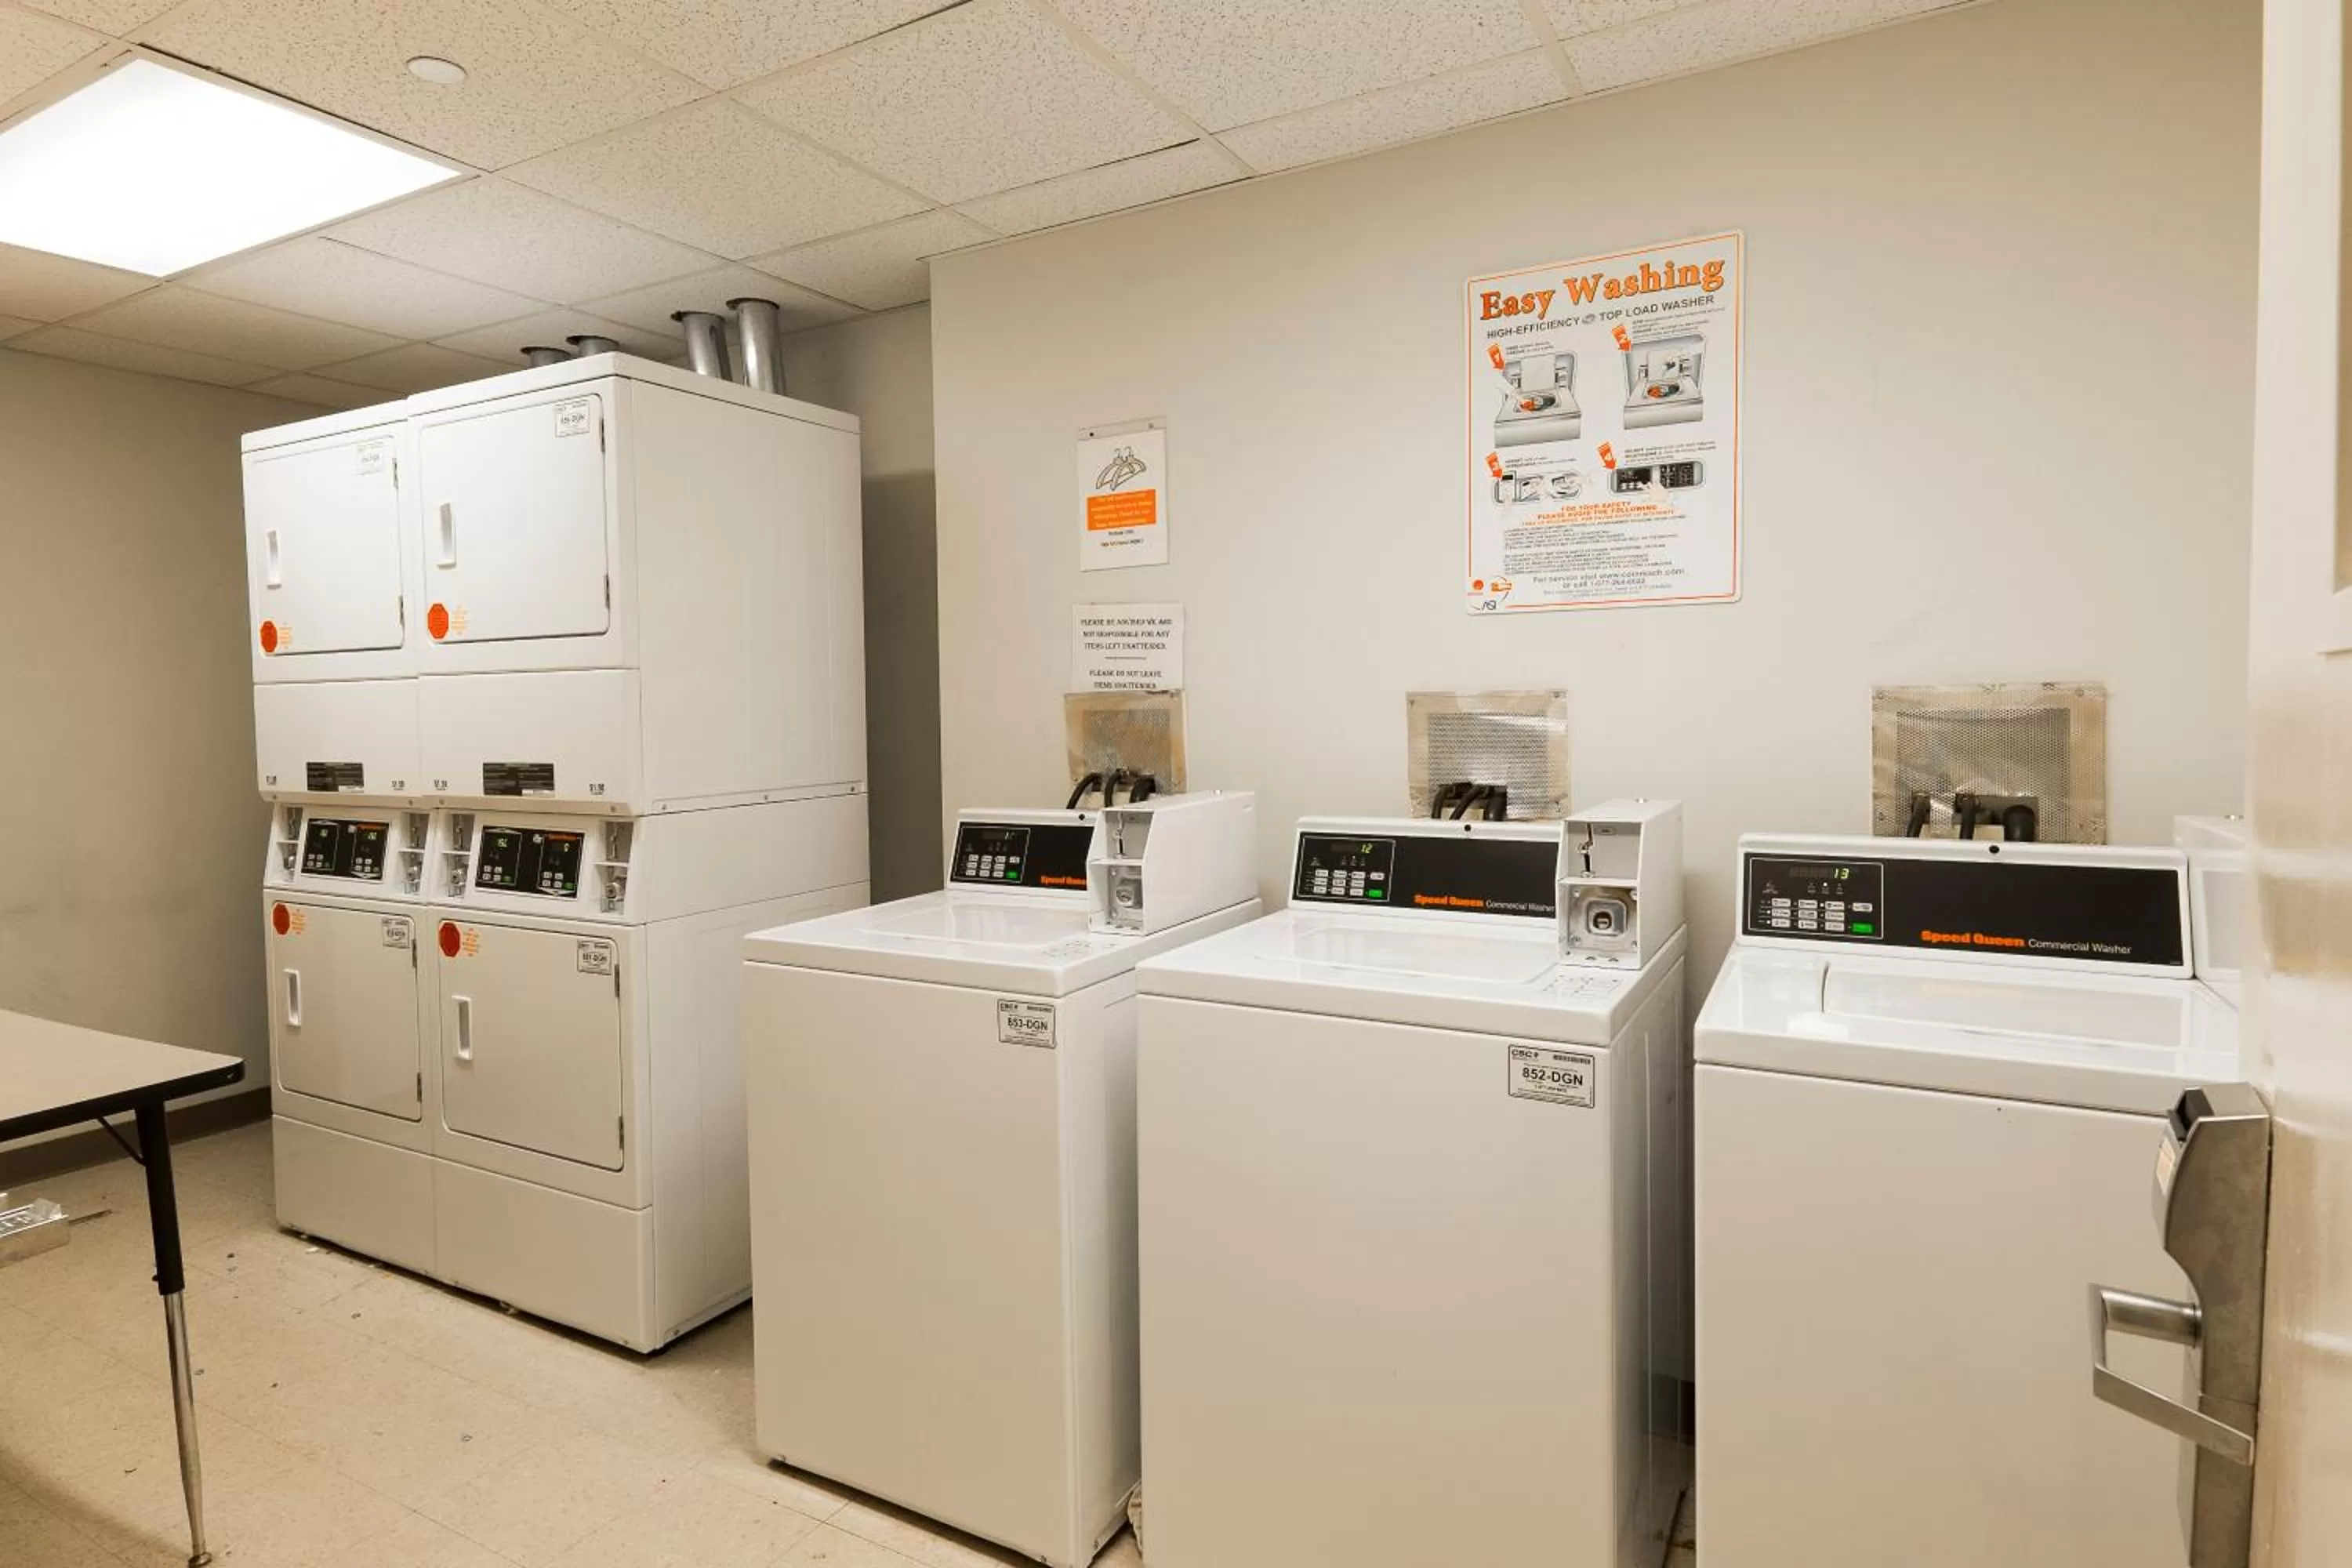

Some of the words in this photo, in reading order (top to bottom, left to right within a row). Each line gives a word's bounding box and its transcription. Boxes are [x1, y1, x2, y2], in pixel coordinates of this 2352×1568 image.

[1480, 288, 1556, 321] Easy
[1563, 260, 1726, 306] Washing
[1486, 317, 1580, 339] HIGH-EFFICIENCY
[1599, 309, 1622, 322] TOP
[1626, 303, 1658, 318] LOAD
[1661, 295, 1715, 313] WASHER
[1834, 868, 1849, 879] 13
[1414, 894, 1448, 906] Speed
[1921, 931, 1970, 943] Speed
[1973, 933, 2025, 947] Queen
[2028, 938, 2090, 952] Commercial
[2092, 942, 2131, 954] Washer
[1523, 1067, 1583, 1086] 852-DGN
